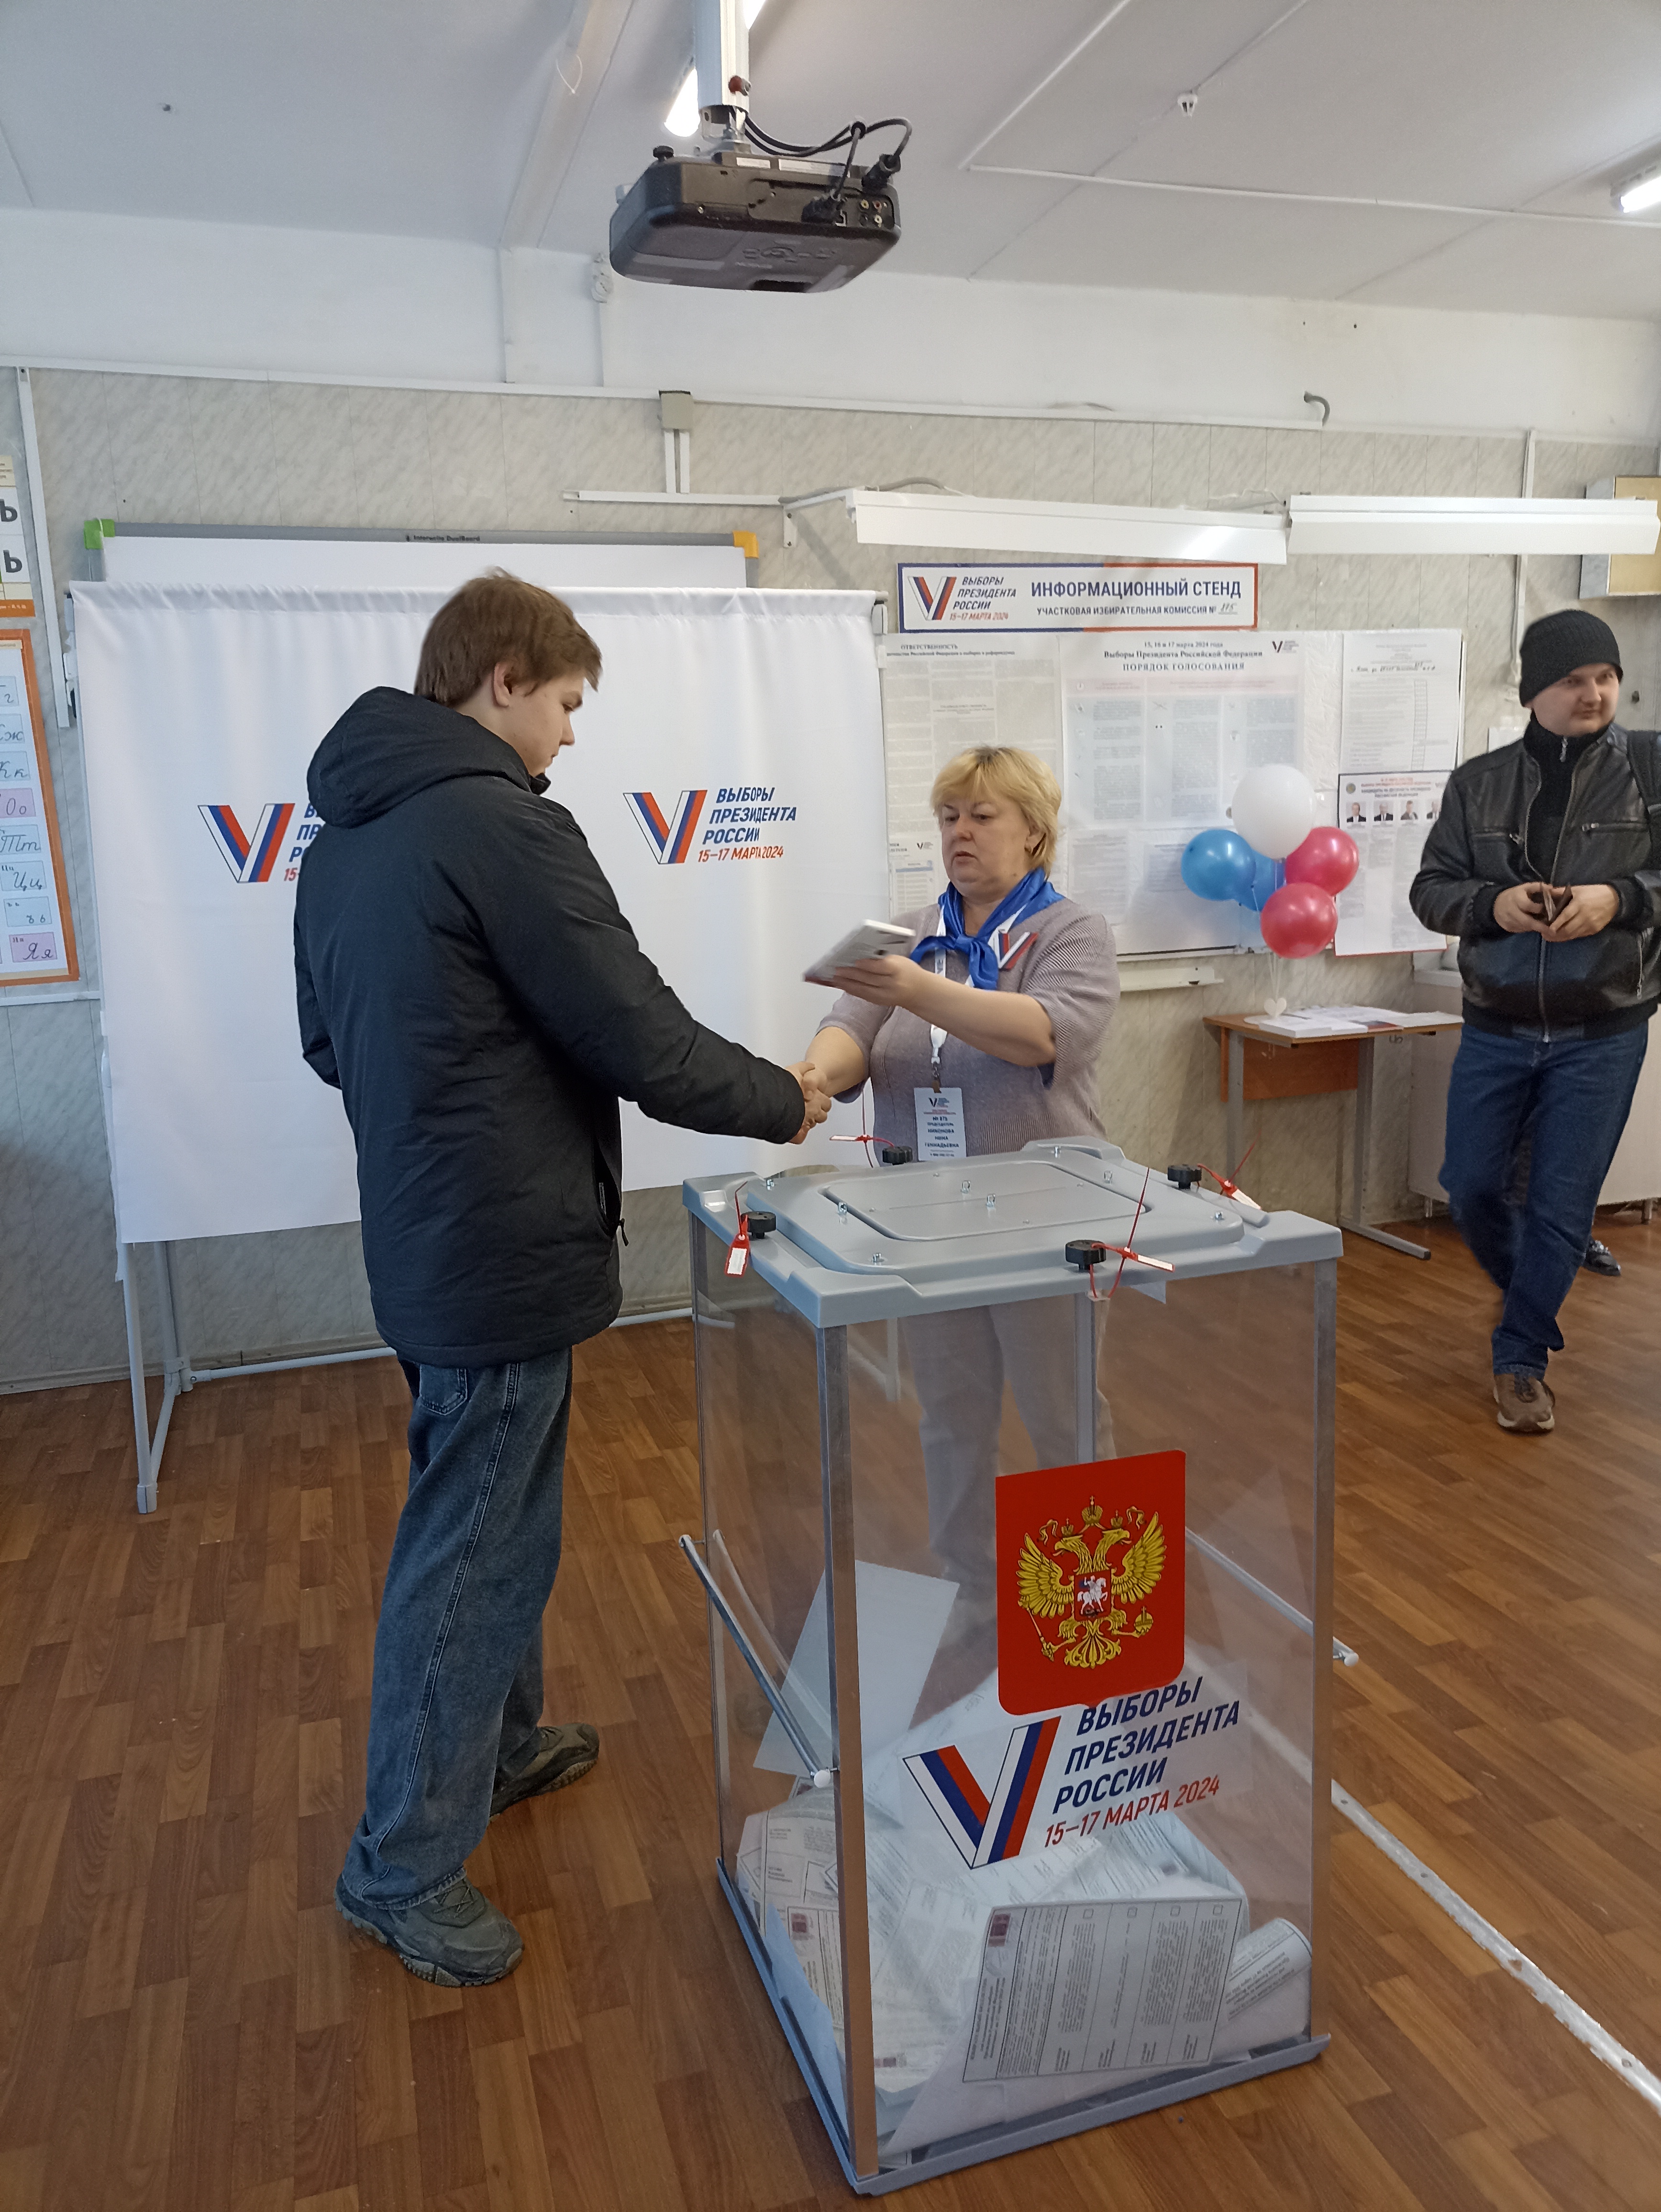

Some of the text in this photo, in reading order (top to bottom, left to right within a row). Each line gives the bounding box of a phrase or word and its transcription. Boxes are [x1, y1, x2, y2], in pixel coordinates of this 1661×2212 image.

[962, 576, 1004, 586] ВЫБОРЫ
[1031, 577, 1241, 599] ИНФОРМАЦИОННЫЙ СТЕНД
[957, 588, 1016, 598] ПРЕЗИДЕНТА
[952, 601, 991, 610] РОССИИ
[1037, 607, 1091, 616] УЧАСТКОВАЯ
[1093, 606, 1162, 616] ИЗБИРАТЕЛЬНАЯ
[1164, 606, 1207, 615] КОМИССИЯ
[992, 612, 1009, 620] 2024
[1136, 650, 1178, 660] Президента
[1123, 662, 1244, 671] ПОРЯДОК ГОЛОСОВАНИЯ
[716, 787, 775, 804] ВЫБОРЫ
[709, 807, 797, 824] ПРЕЗИДЕНТА
[702, 828, 760, 845] РОССИИ
[731, 847, 761, 860] МАРТА
[761, 846, 784, 859] 2024
[1076, 1676, 1203, 1736] ВЫБОРЫ
[1064, 1700, 1240, 1775] ПРЕЗИДЕНТА
[1052, 1757, 1168, 1814] РОССИИ
[1103, 1790, 1169, 1830] МАРТА
[1174, 1775, 1220, 1808] 2024
